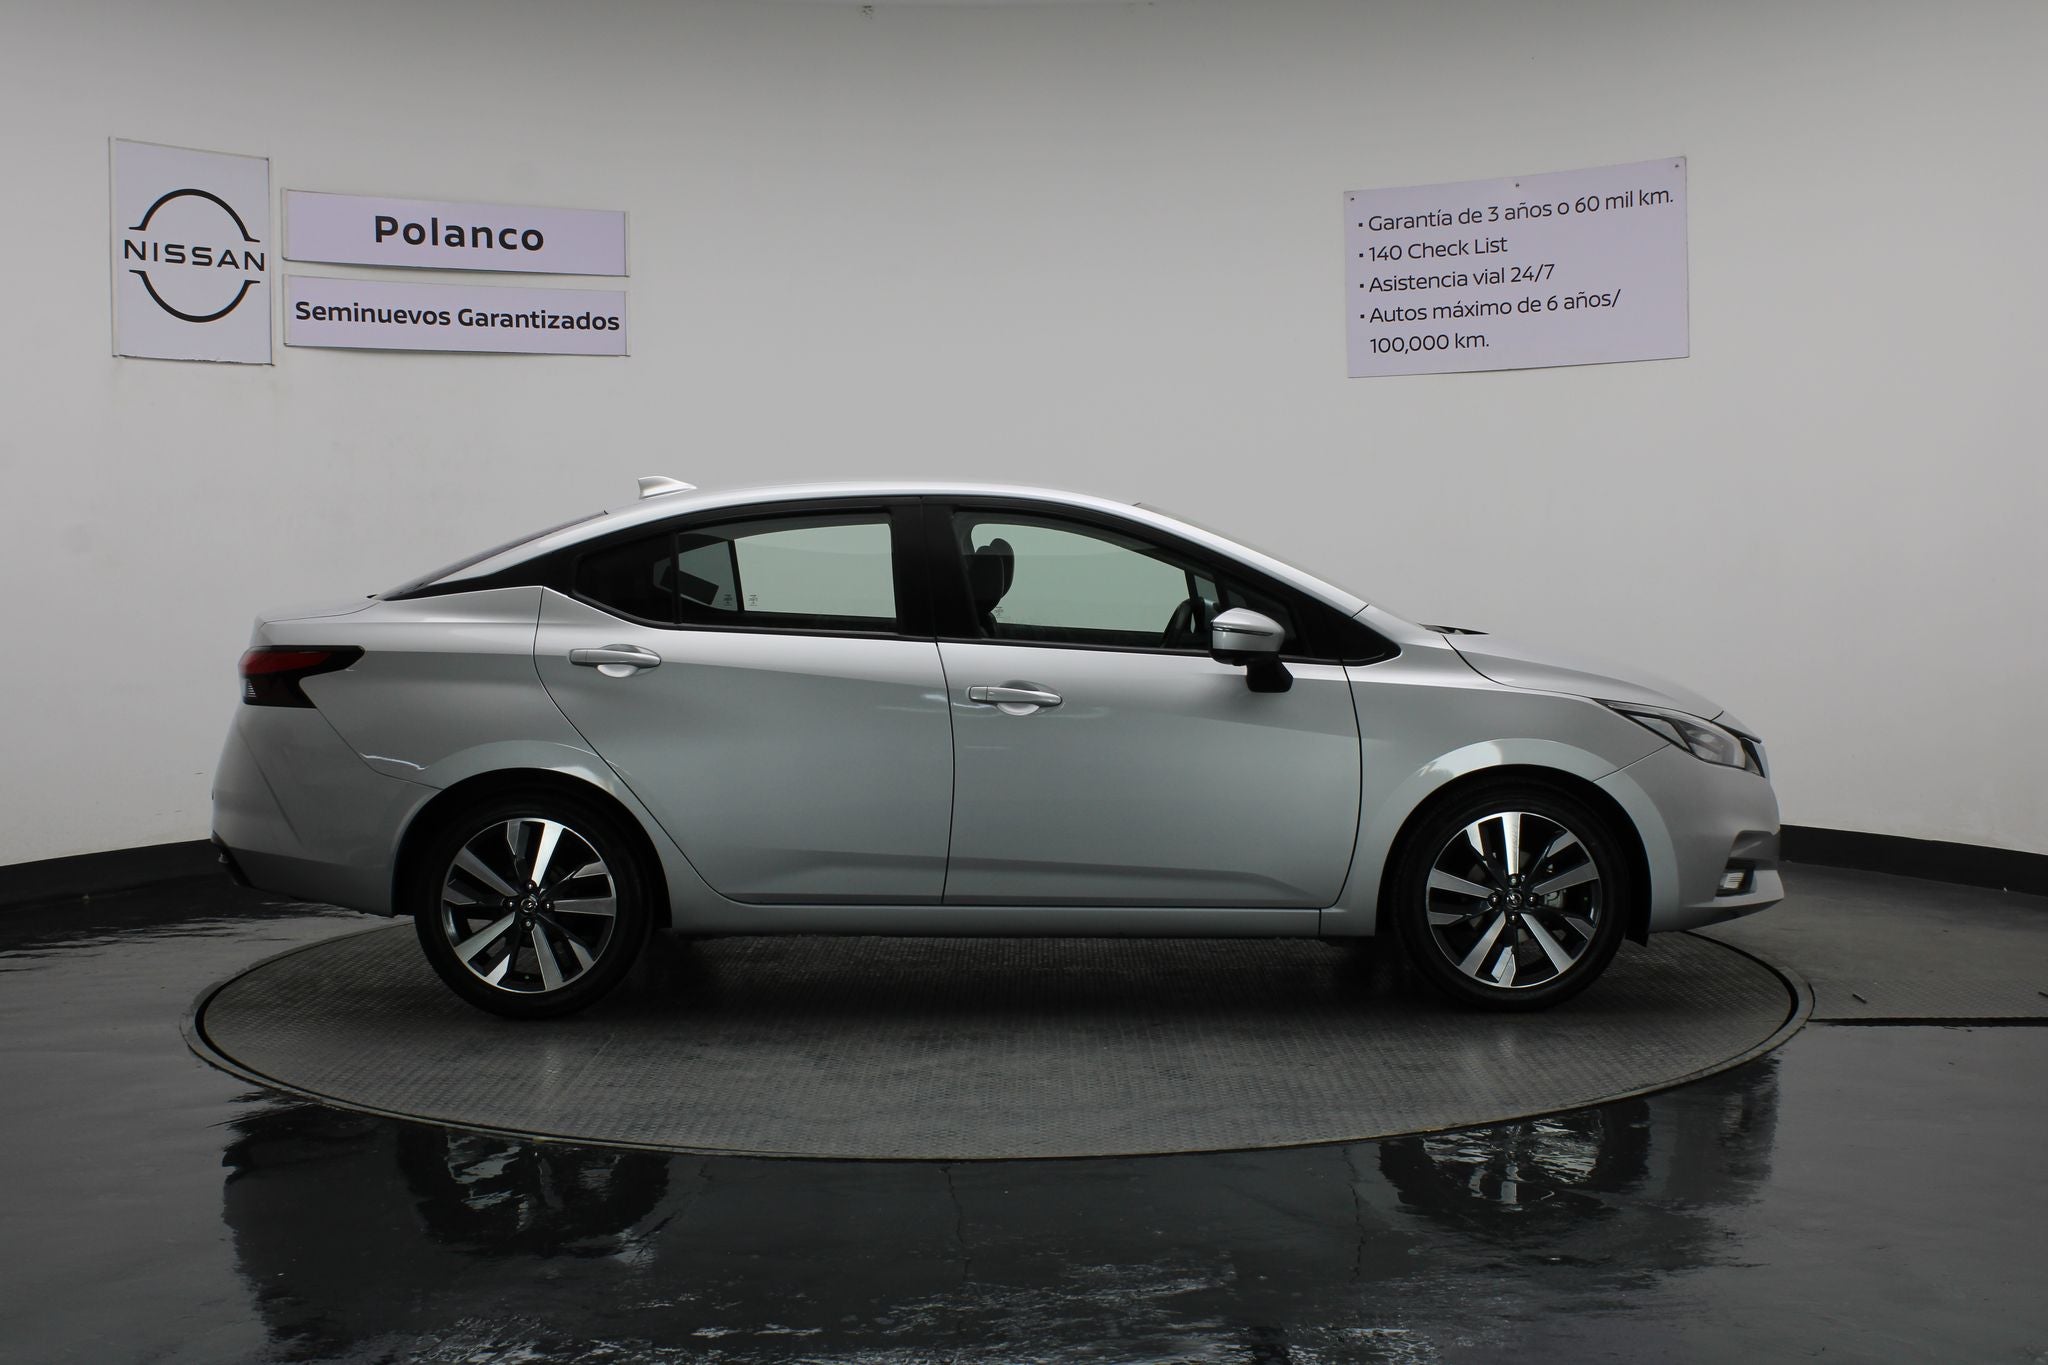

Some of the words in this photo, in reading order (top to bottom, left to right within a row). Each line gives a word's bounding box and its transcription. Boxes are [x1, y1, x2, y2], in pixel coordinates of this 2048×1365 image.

[1368, 208, 1453, 232] Garantía
[1457, 207, 1483, 225] de
[1487, 205, 1500, 223] 3
[1504, 201, 1553, 221] años
[1557, 201, 1570, 216] o
[1574, 195, 1600, 214] 60
[1605, 190, 1634, 211] mil
[1638, 188, 1674, 207] km.
[374, 215, 544, 252] Polanco
[1368, 244, 1403, 263] 140
[1407, 239, 1470, 260] Check
[1474, 236, 1509, 255] List
[124, 239, 265, 272] NISSAN
[1368, 270, 1468, 293] Asistencia
[1472, 266, 1505, 286] vial
[1510, 263, 1556, 283] 24/7
[295, 300, 452, 326] Seminuevos
[457, 308, 620, 331] Garantizados
[1369, 306, 1428, 324] Autos
[1432, 300, 1513, 320] máximo
[1517, 296, 1542, 314] de
[1546, 294, 1559, 312] 6
[1563, 288, 1622, 311] años/
[1369, 333, 1450, 355] 100,000
[1454, 332, 1490, 350] km.
